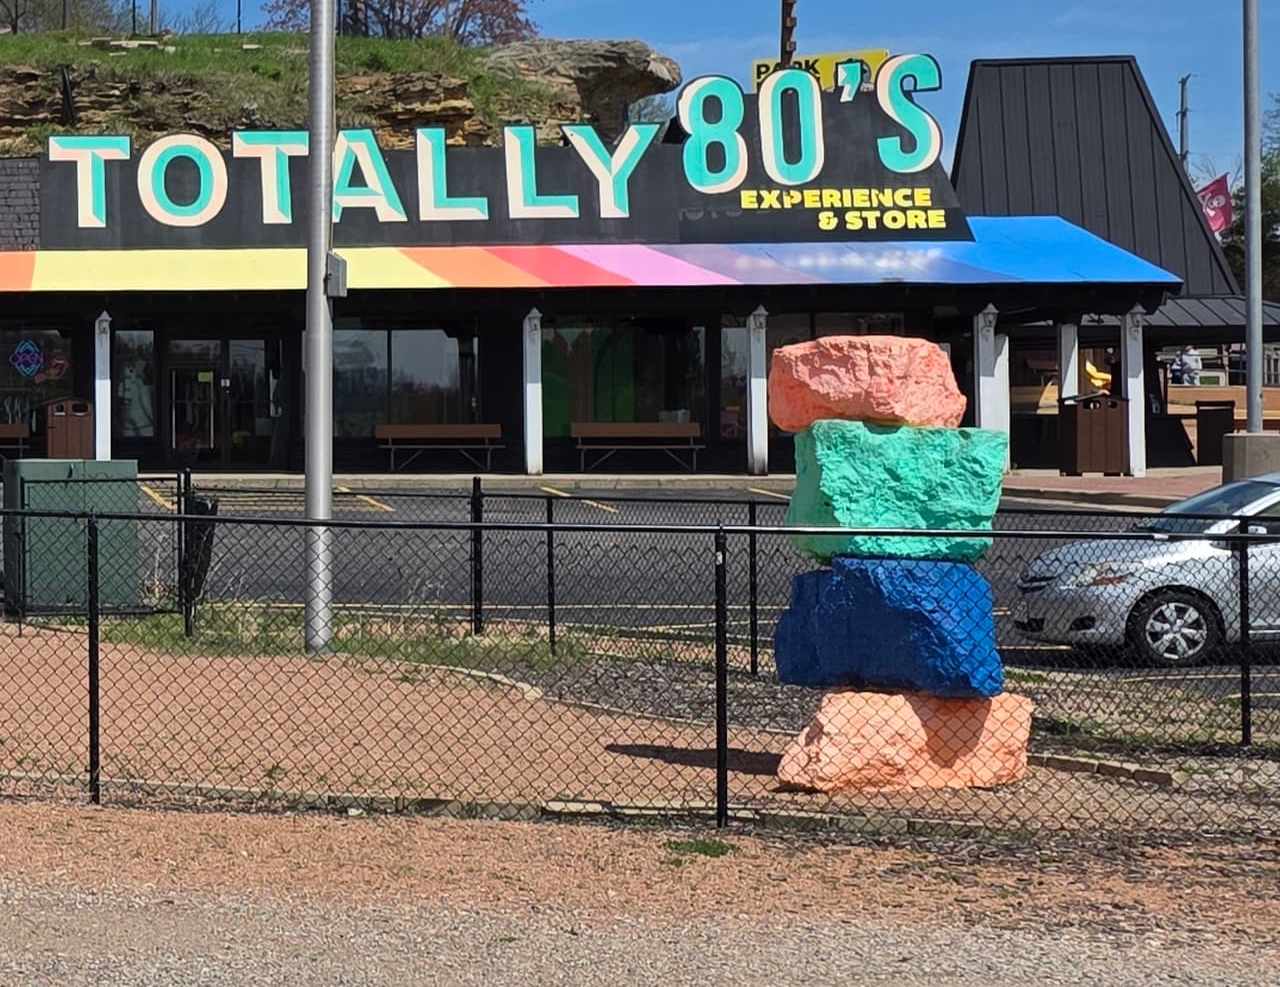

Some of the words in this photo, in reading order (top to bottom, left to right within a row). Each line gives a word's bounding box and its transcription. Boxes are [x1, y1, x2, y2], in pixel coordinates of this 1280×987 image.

[48, 124, 661, 228] TOTALLY
[677, 53, 942, 195] 80'S
[739, 188, 932, 209] EXPERIENCE
[817, 210, 838, 231] &
[845, 209, 946, 230] STORE
